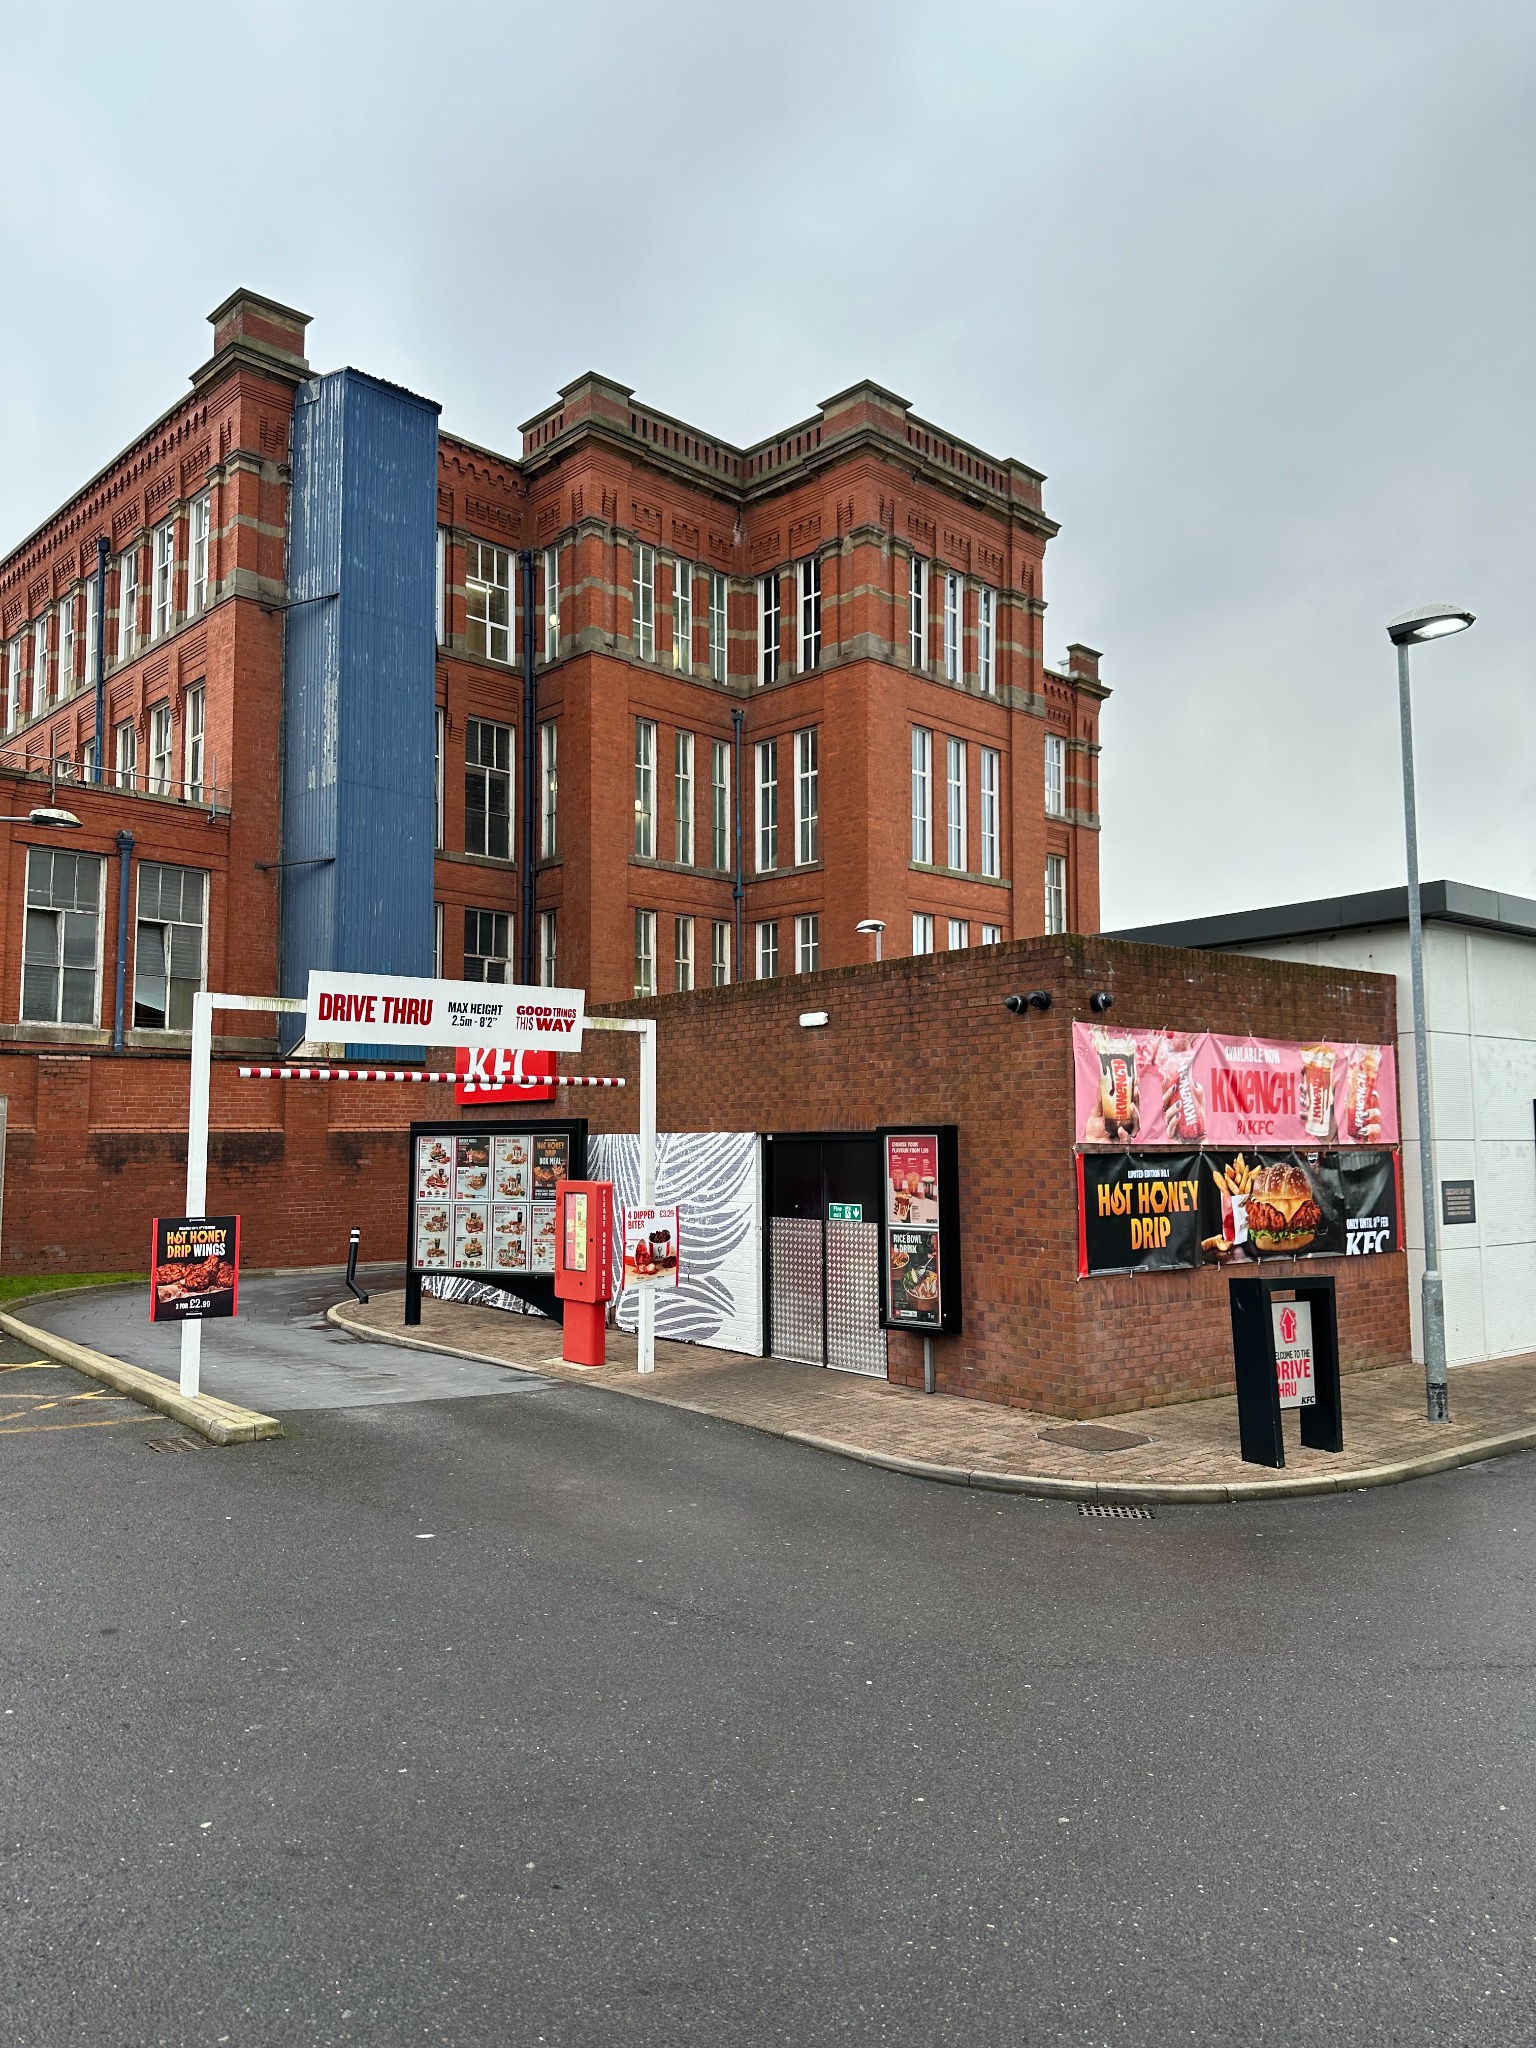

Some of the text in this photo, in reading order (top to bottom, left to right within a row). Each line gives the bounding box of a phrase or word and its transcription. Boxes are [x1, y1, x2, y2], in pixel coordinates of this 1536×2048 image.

[318, 993, 433, 1026] DRIVE THRU
[448, 1002, 503, 1016] MAX HEIGHT
[516, 1005, 577, 1018] GOOD THINGS
[452, 1015, 472, 1027] 2.5m
[516, 1016, 576, 1033] THIS WAY
[1225, 1046, 1280, 1064] AVAILABLE NOW
[464, 1047, 538, 1092] KFC
[1248, 1120, 1274, 1135] KFC
[547, 1141, 565, 1149] HONEY
[1098, 1180, 1199, 1217] HOT HONEY
[628, 1211, 632, 1220] 4
[634, 1210, 655, 1220] DIPPED
[628, 1220, 645, 1229] BITES
[167, 1230, 227, 1245] HOT HONEY
[893, 1234, 922, 1244] RICE BOWL
[1130, 1216, 1171, 1250] DRIP
[899, 1244, 918, 1254] DRINK
[1346, 1230, 1390, 1256] KFC
[167, 1243, 226, 1258] DRIP WINGS
[189, 1299, 211, 1309] £2.99
[1275, 1349, 1310, 1360] ELCOME TO THE
[1278, 1382, 1297, 1398] HRU
[1301, 1395, 1315, 1404] KFC
